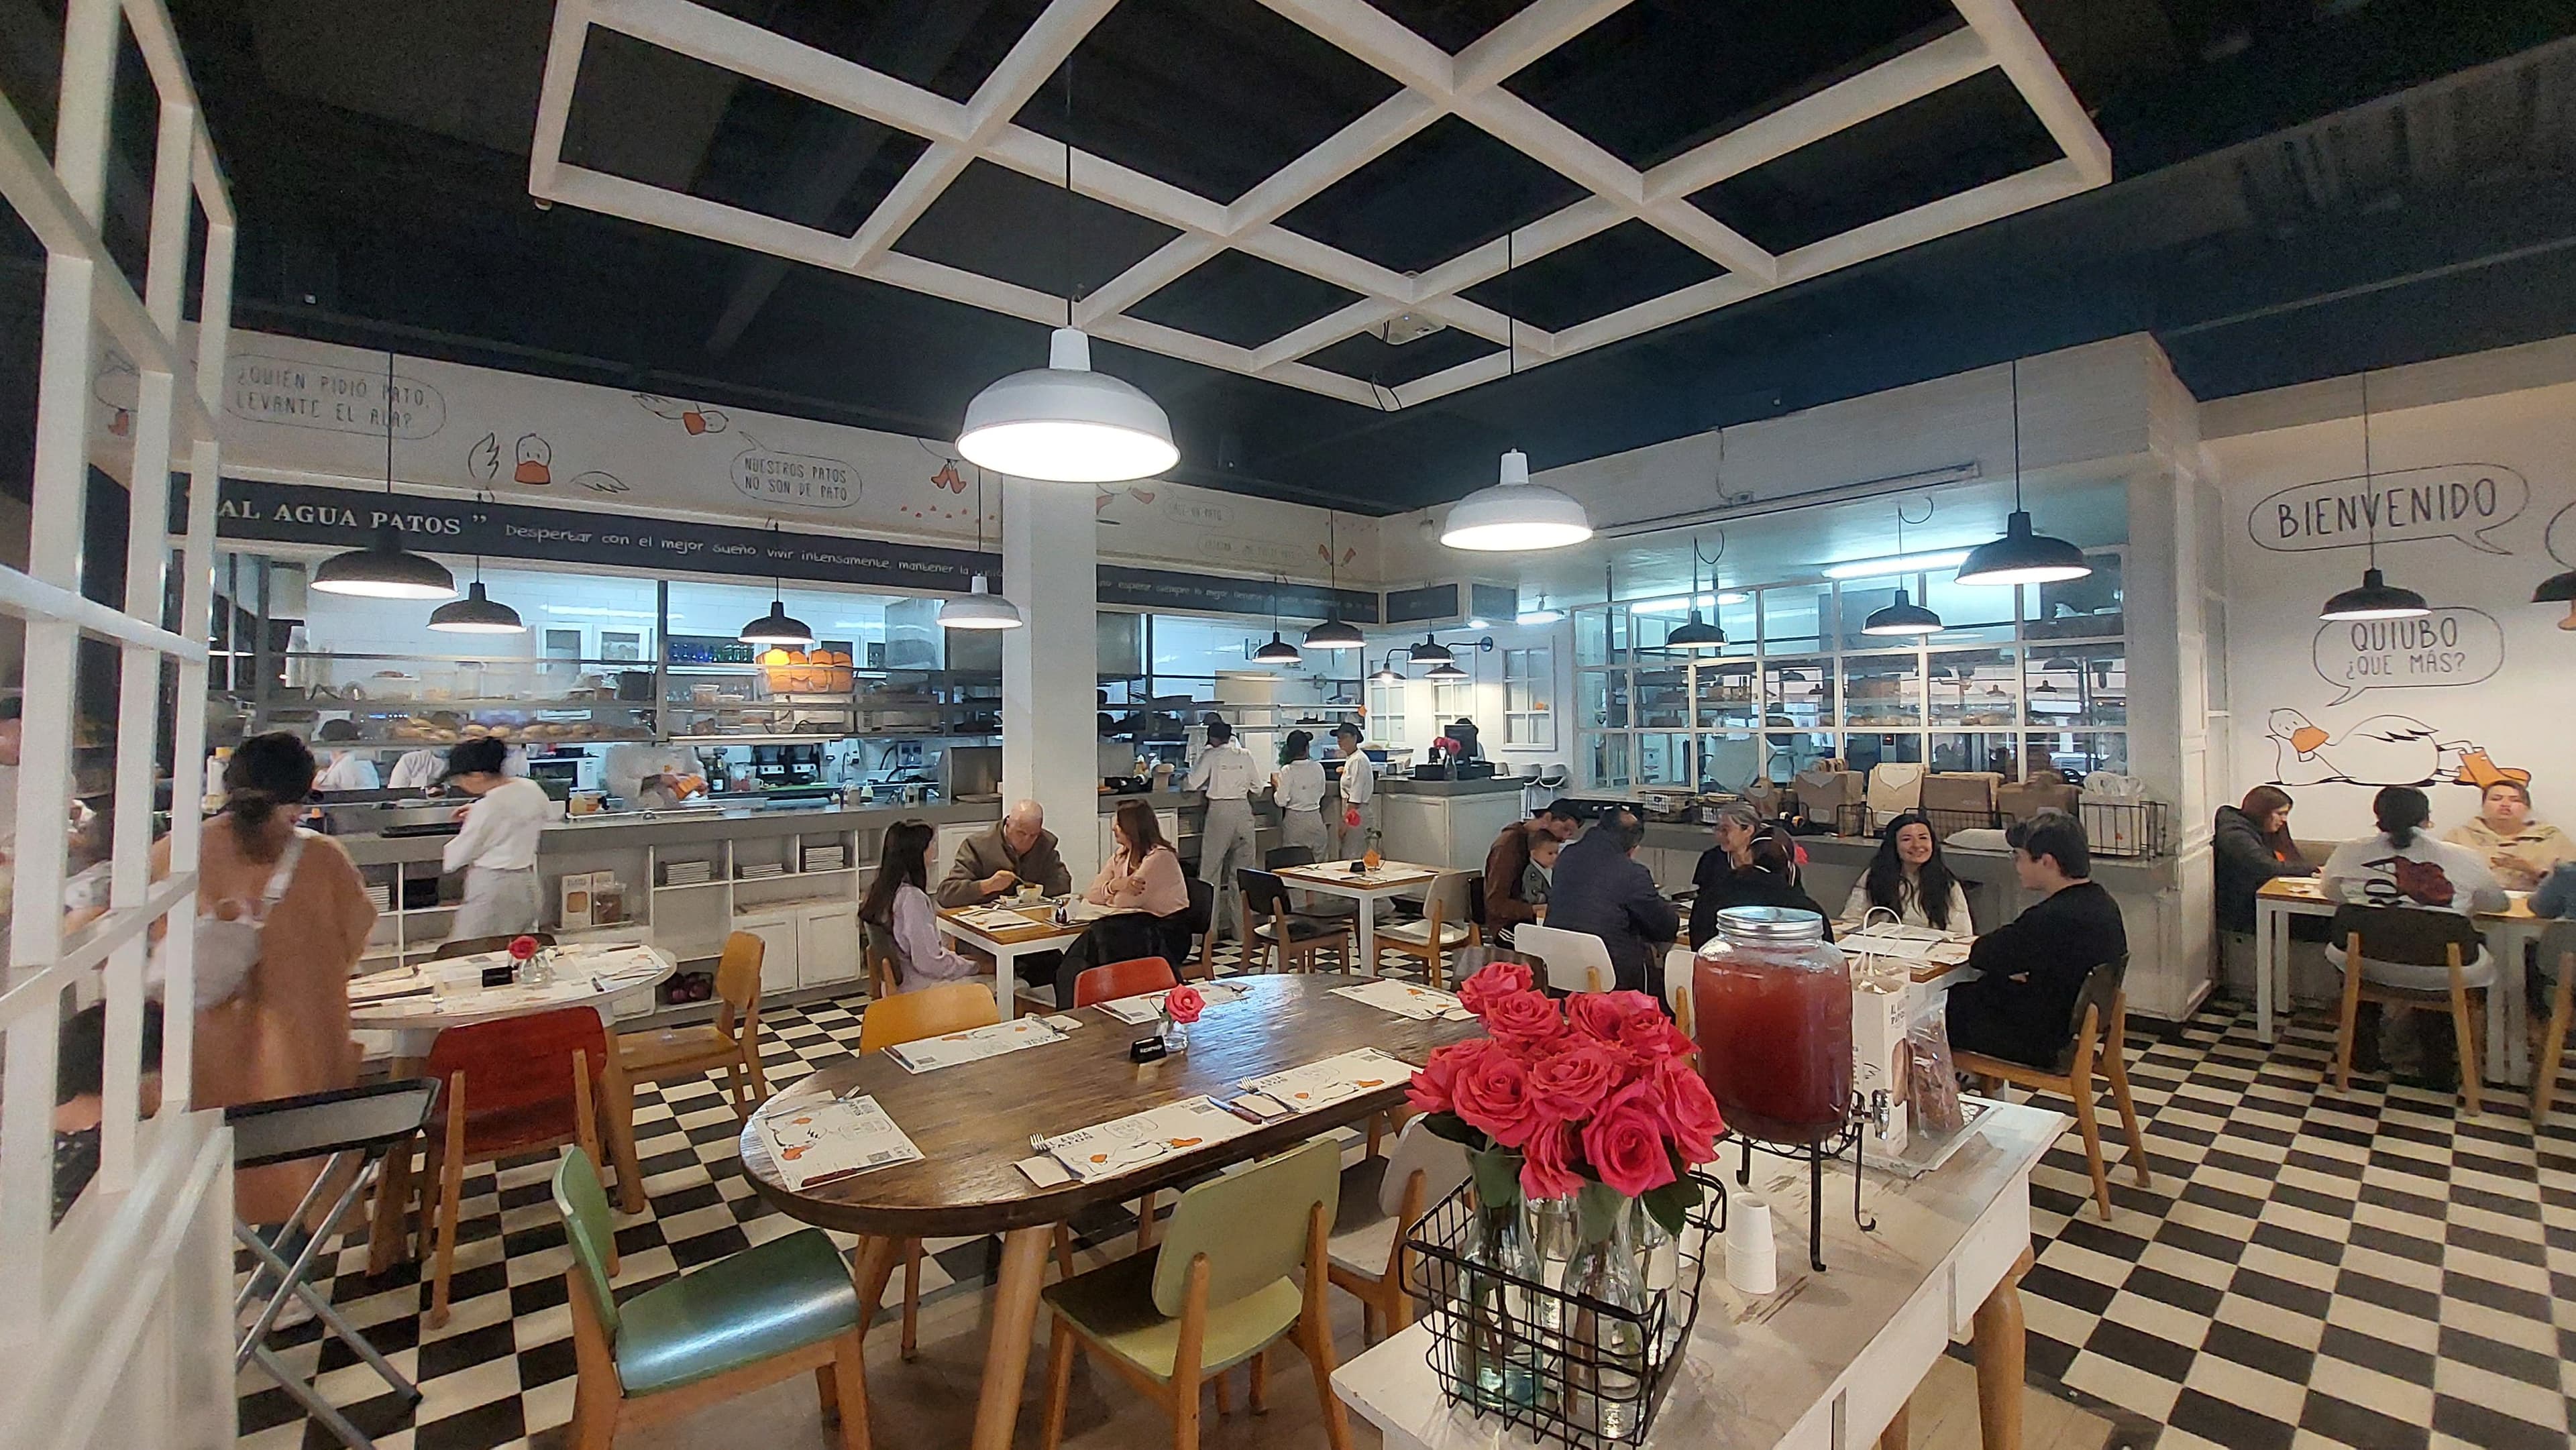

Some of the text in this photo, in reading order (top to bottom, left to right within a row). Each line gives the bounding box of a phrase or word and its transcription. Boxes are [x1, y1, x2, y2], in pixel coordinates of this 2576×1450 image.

[236, 390, 320, 418] LEVANTE
[337, 404, 354, 422] EL
[745, 457, 847, 484] NUESTROS PATOS
[745, 476, 847, 502] NO SON DE PATO
[2277, 478, 2497, 539] BIENVENIDO
[219, 500, 260, 519] AL
[274, 504, 358, 527] AGUA
[370, 511, 461, 535] PATOS
[506, 524, 592, 543] Despertar
[602, 535, 630, 545] con
[639, 536, 652, 547] el
[661, 539, 704, 555] mejor
[767, 549, 794, 559] vivir
[899, 561, 955, 573] mantener
[960, 565, 969, 575] la
[2351, 617, 2457, 652] QUIUBO
[2410, 649, 2466, 674] MÁS?
